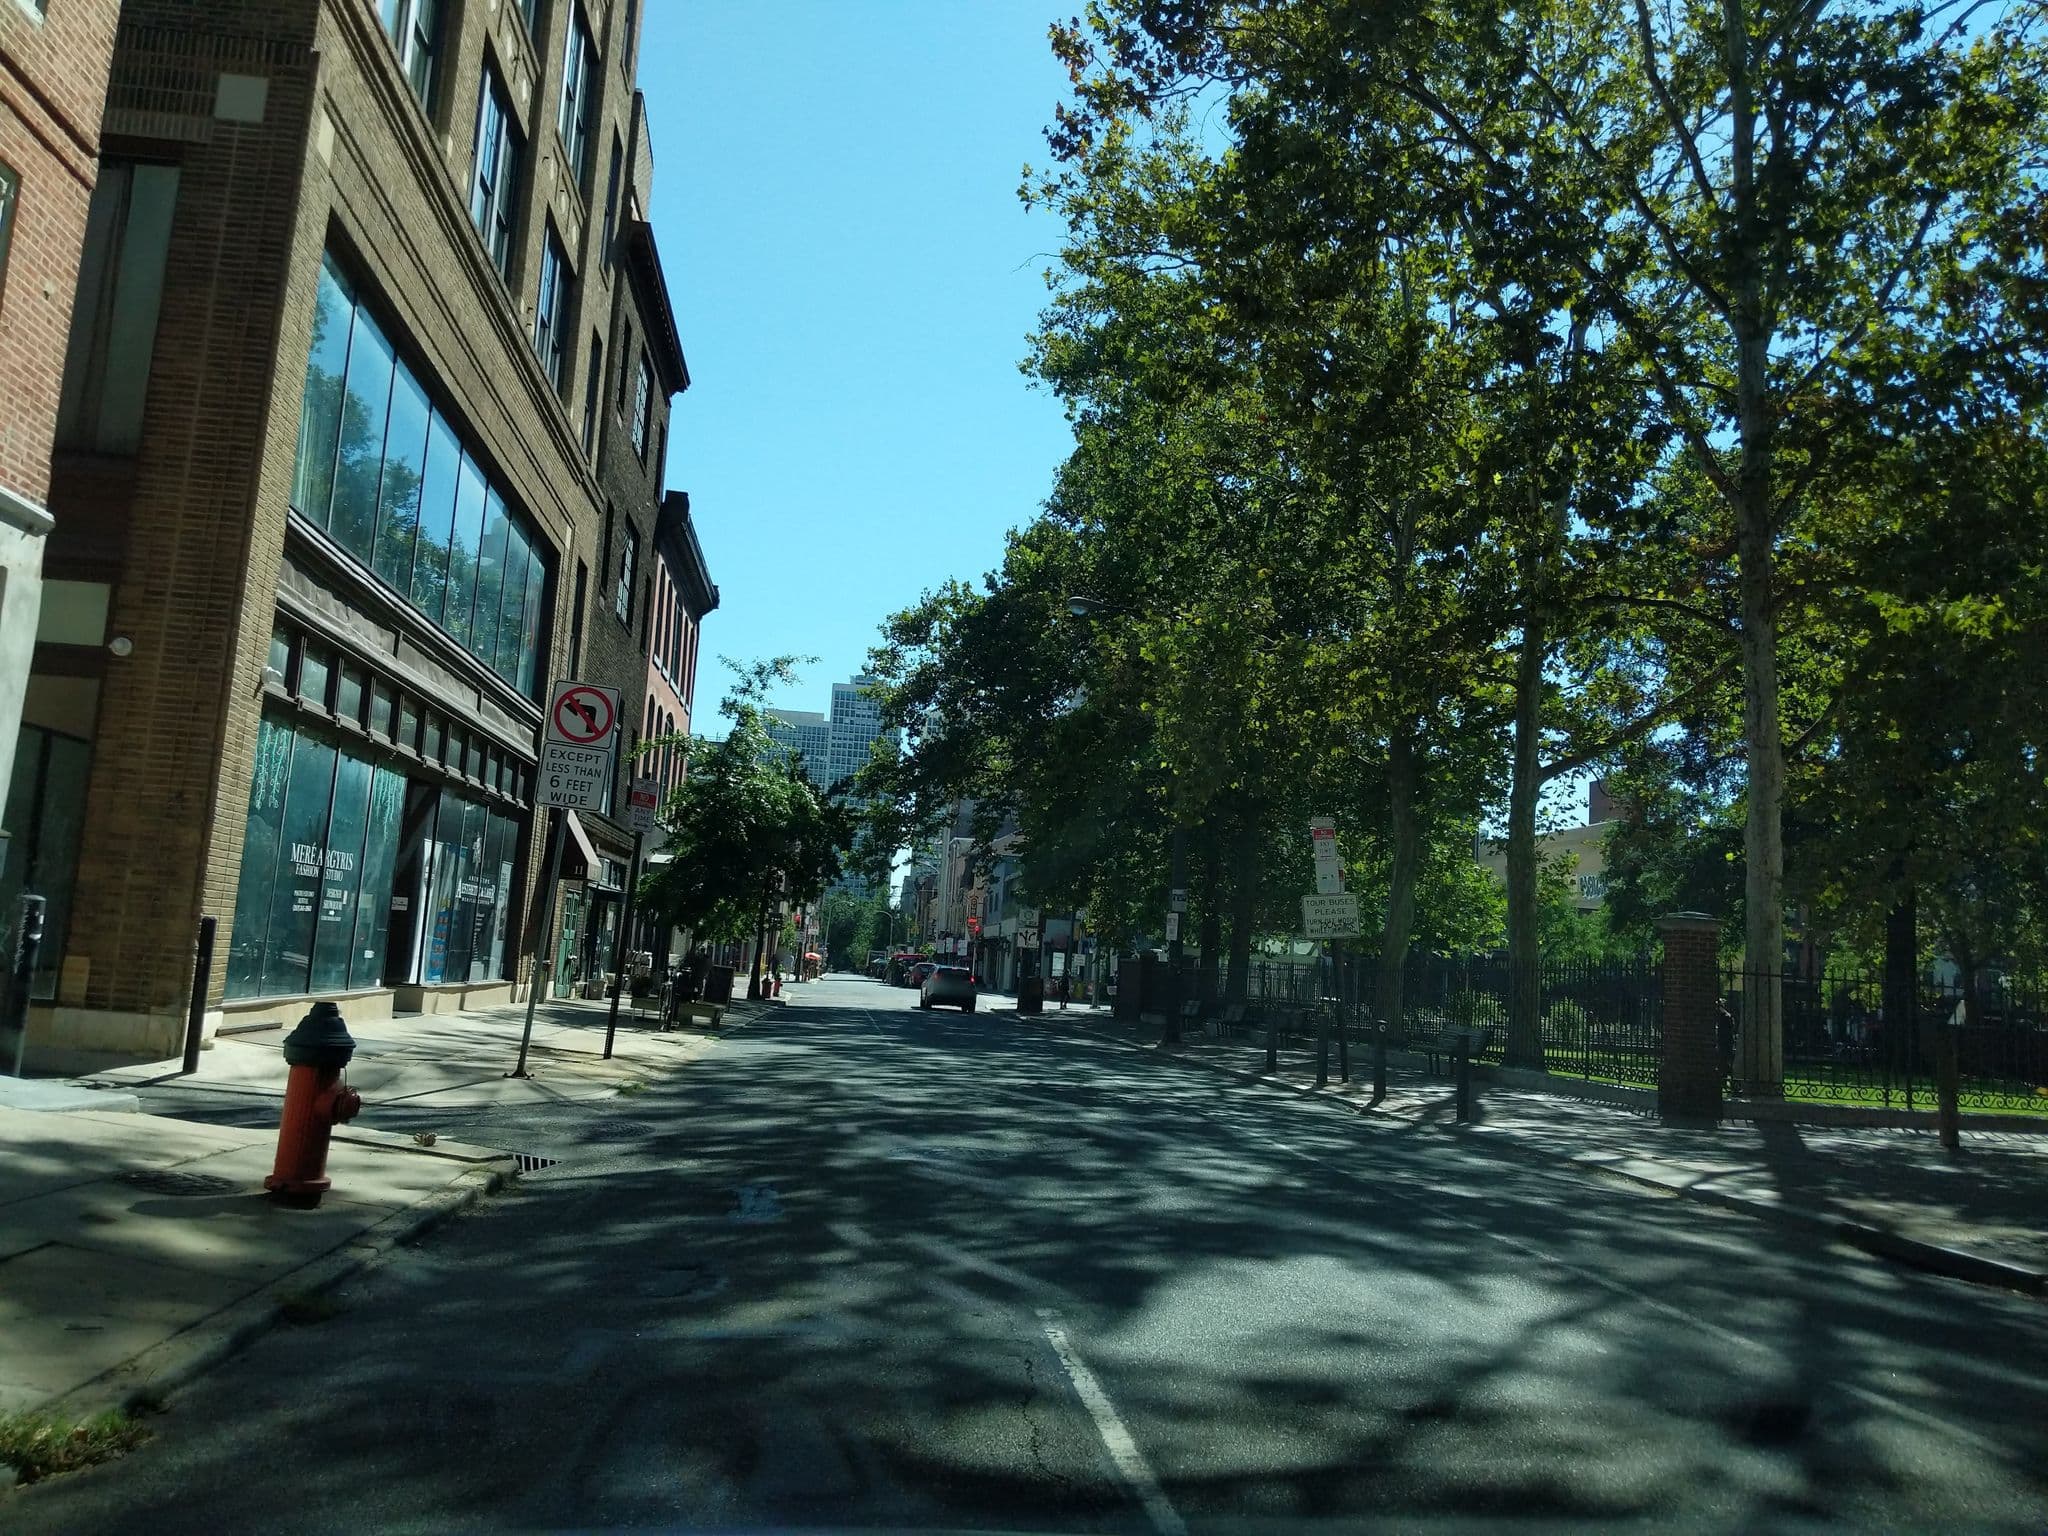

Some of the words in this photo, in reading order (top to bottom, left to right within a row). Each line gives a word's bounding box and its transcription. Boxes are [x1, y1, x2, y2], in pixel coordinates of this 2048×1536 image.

[550, 749, 601, 764] EXCEPT
[546, 762, 570, 774] LESS
[574, 765, 601, 778] THAN
[550, 775, 560, 788] 6
[566, 779, 593, 792] FEET
[550, 792, 587, 806] WIDE
[290, 842, 317, 865] MERÉ
[295, 863, 320, 878] FASHION
[325, 868, 344, 882] STUDIO
[1329, 898, 1355, 906] BUSES
[1314, 907, 1348, 916] PLEASE
